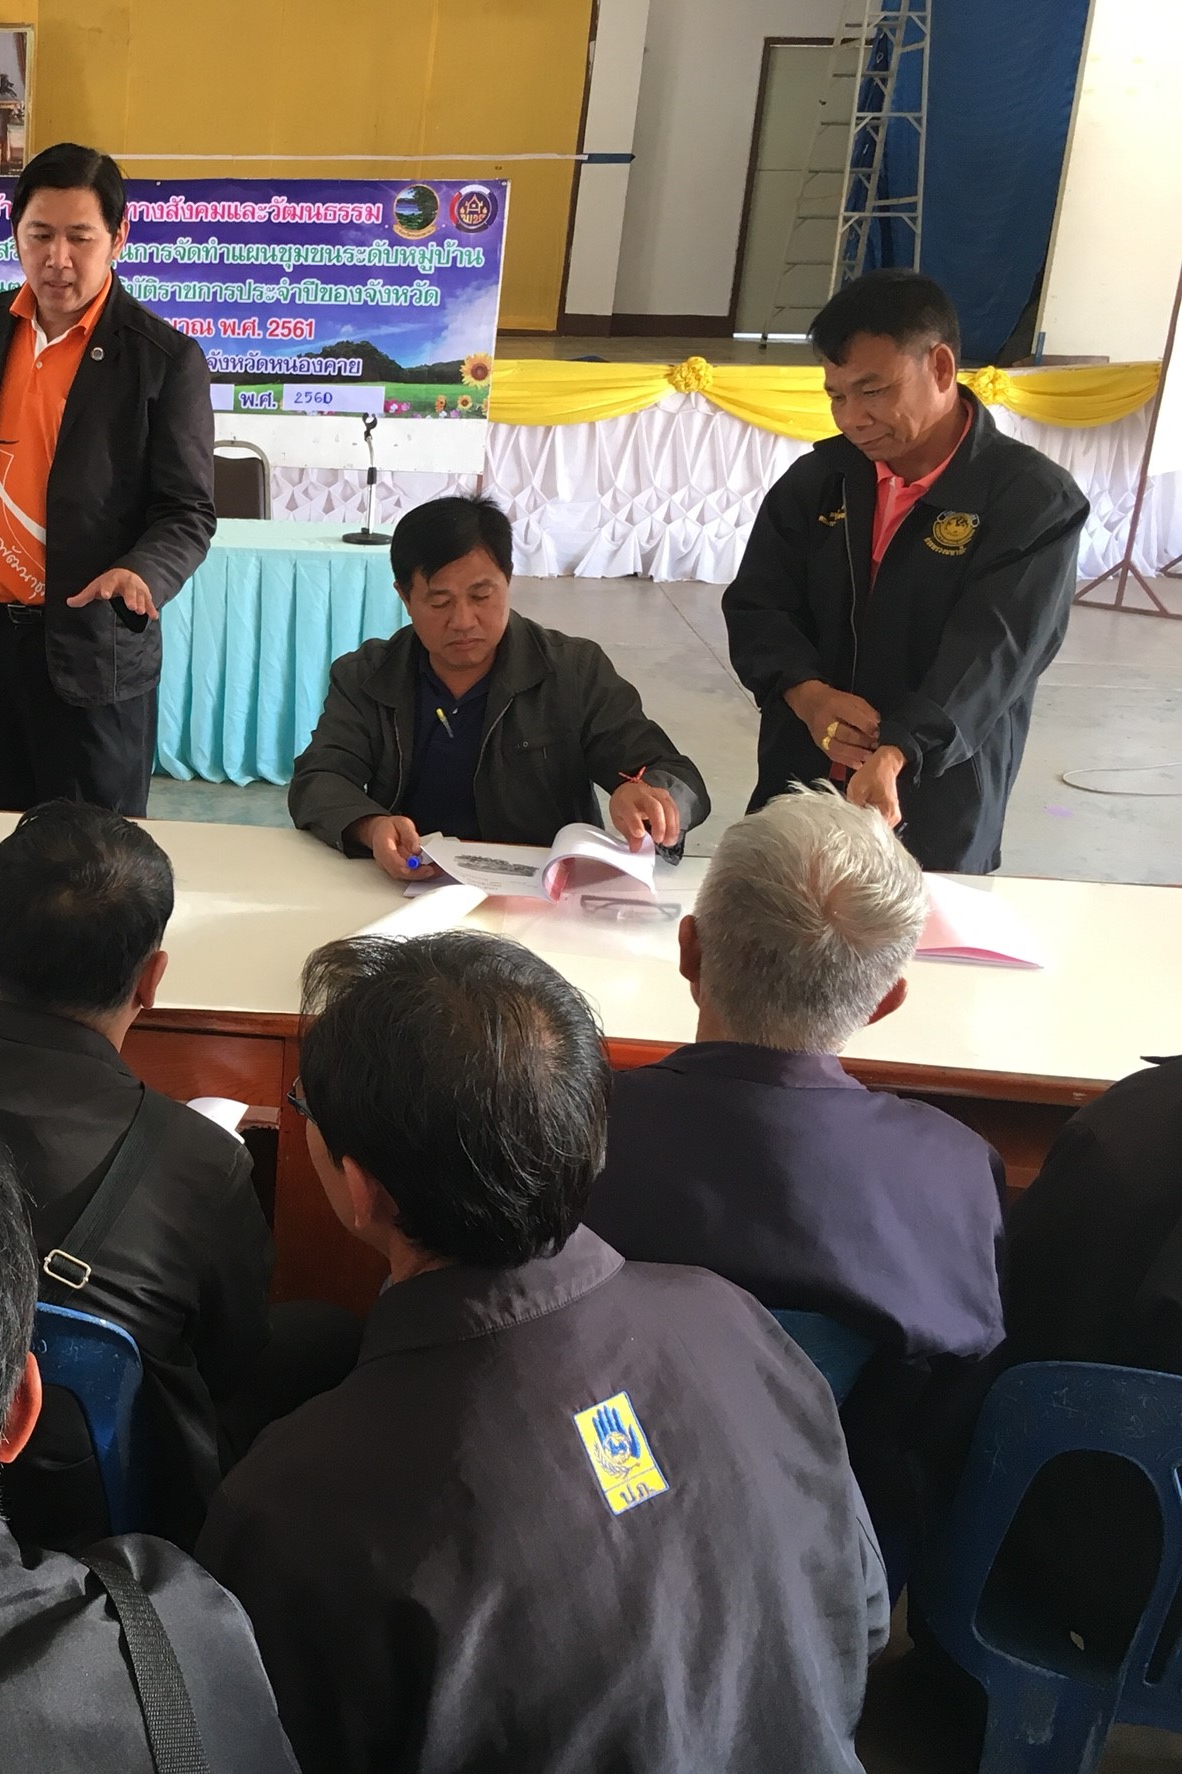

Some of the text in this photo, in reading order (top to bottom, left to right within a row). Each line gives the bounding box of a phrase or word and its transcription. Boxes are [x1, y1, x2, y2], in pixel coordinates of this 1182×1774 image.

[118, 236, 485, 274] นการจัดทำแผนชุมชนระดับหมู่บ้าน
[119, 274, 440, 306] บัติราชการประจำปีของจังหวัด
[219, 317, 263, 338] พ.ศ.
[266, 317, 315, 340] 2561
[206, 349, 363, 376] จังหวัดหนองคาย
[239, 390, 278, 409] พ.ศ.
[293, 391, 334, 405] 2560
